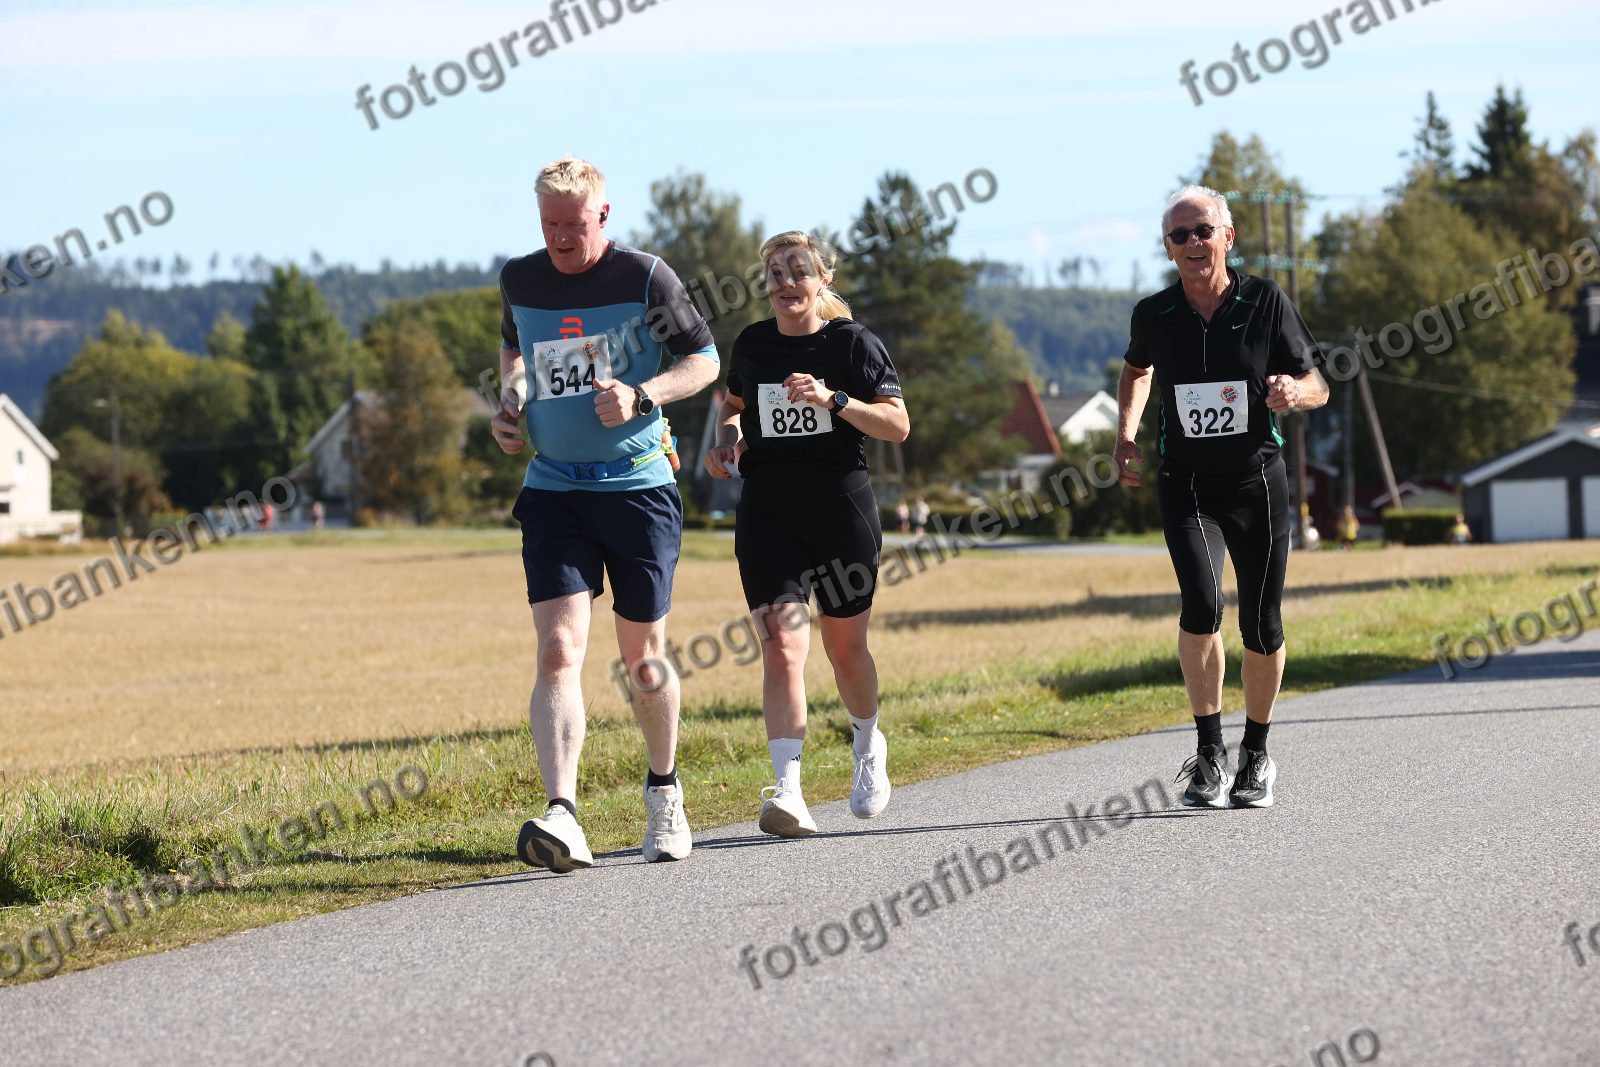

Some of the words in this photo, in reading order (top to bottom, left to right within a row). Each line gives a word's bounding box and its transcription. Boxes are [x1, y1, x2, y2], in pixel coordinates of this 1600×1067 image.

[550, 363, 596, 396] 544
[772, 406, 818, 434] 828
[1189, 406, 1235, 436] 322
